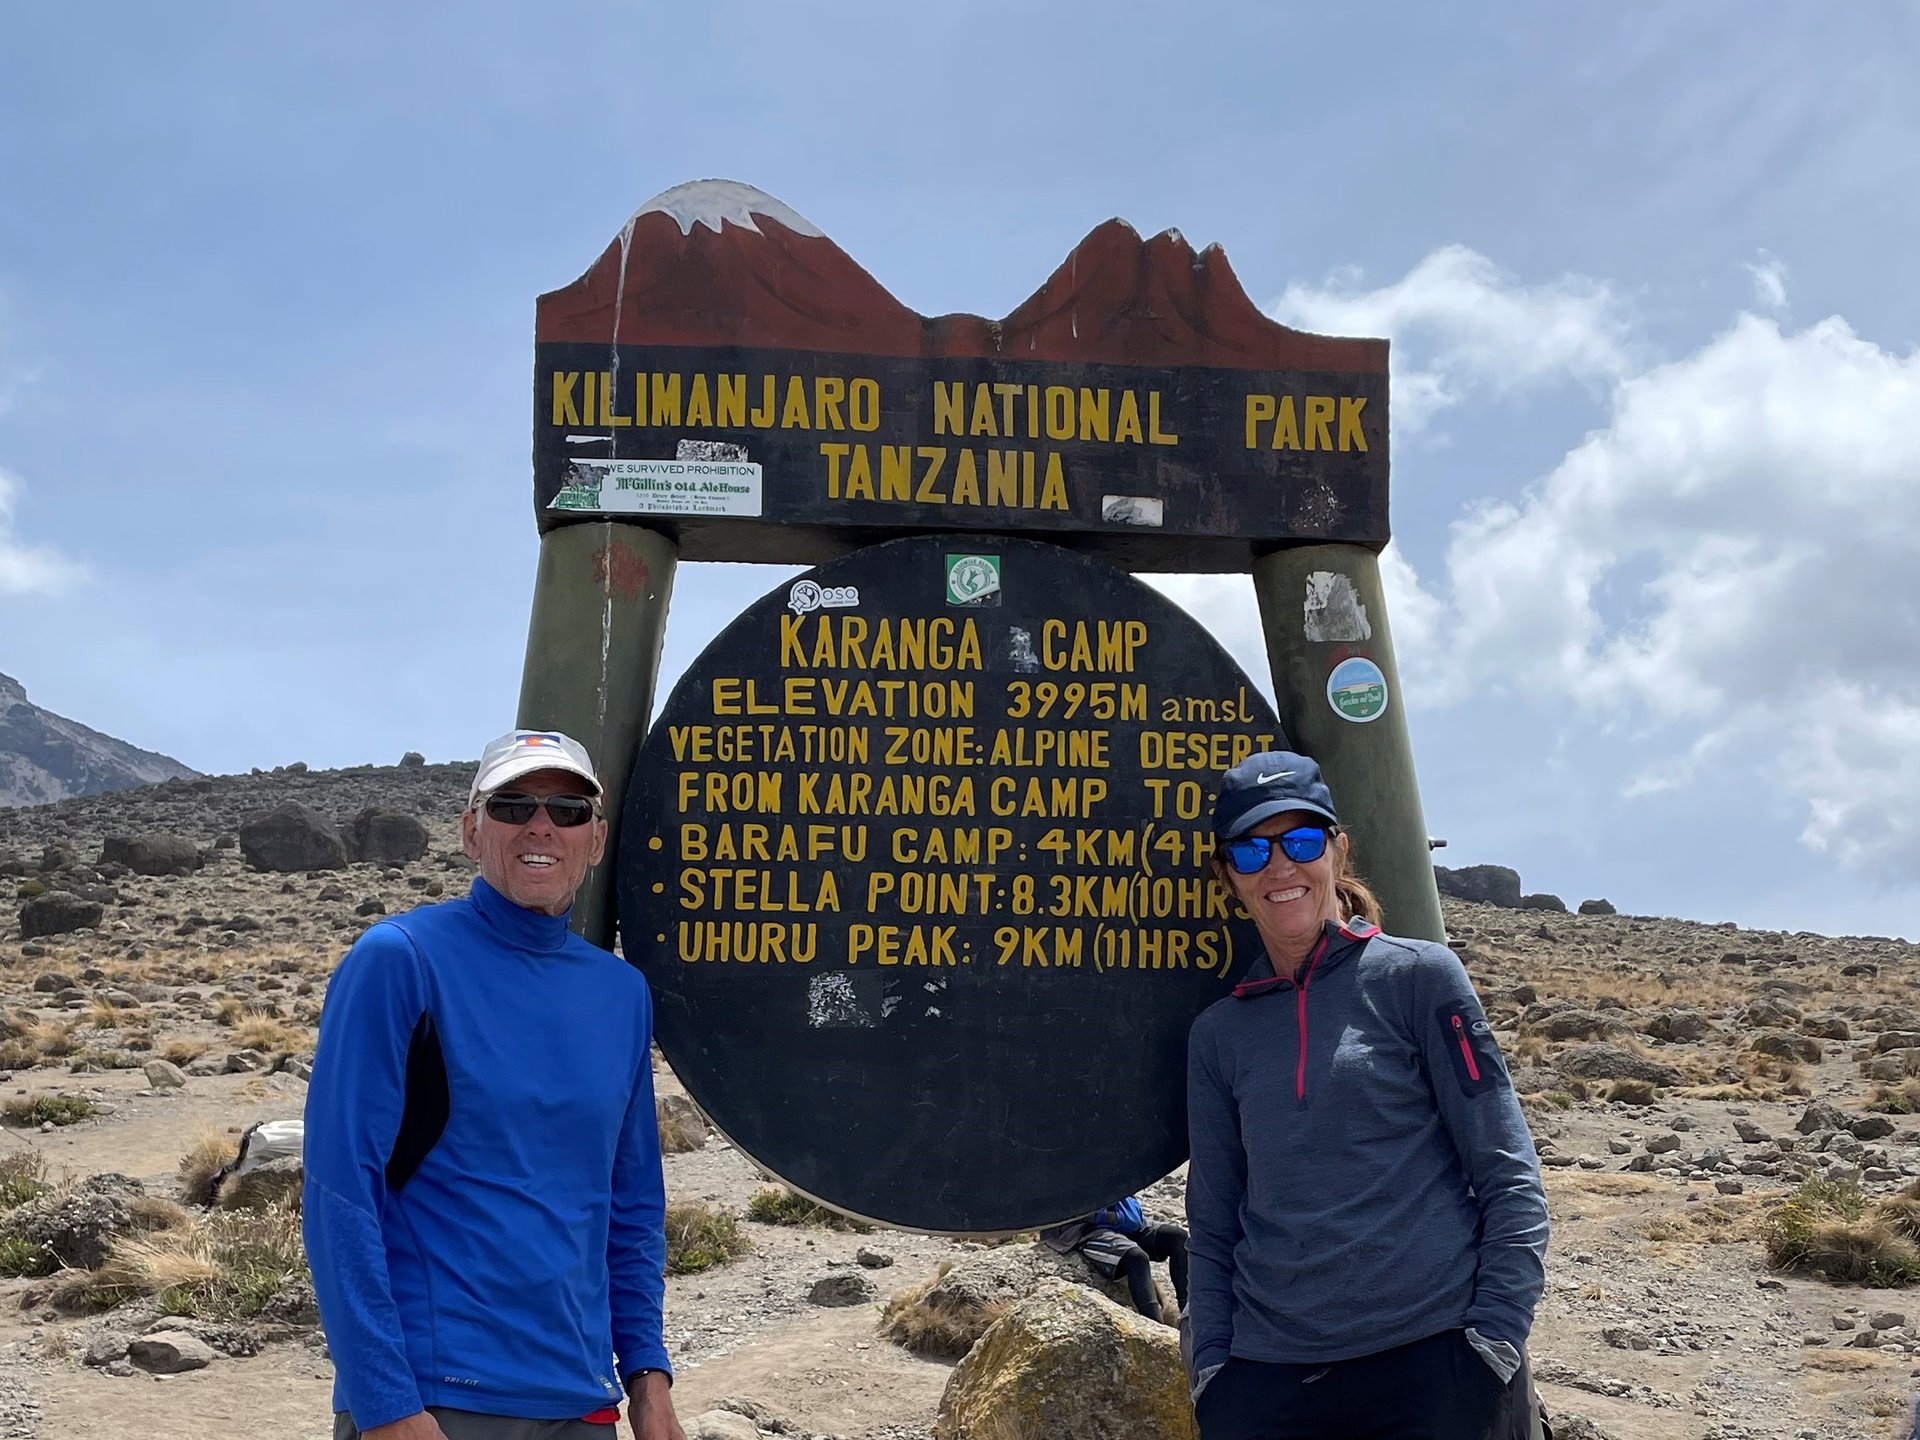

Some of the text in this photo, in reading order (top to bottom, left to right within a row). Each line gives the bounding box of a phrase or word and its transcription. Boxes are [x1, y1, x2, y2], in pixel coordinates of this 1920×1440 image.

[552, 371, 1369, 453] KILIMANJARO NATIONAL PARK
[606, 463, 755, 476] WE SURVIVED PROHIBITION
[820, 442, 1070, 511] TANZANIA
[781, 614, 1148, 674] KARANGA CAMP
[712, 677, 1256, 724] ELEVATION 3995M amsl
[668, 724, 869, 764] VEGETATION
[678, 771, 1217, 822] FROM KARANGA CAMP TO:
[680, 823, 869, 863] BARAFU
[679, 867, 842, 914] STELLA
[678, 921, 818, 964] UHURU
[848, 924, 972, 967] PEAK:
[444, 1375, 479, 1387] DRI-FIT
